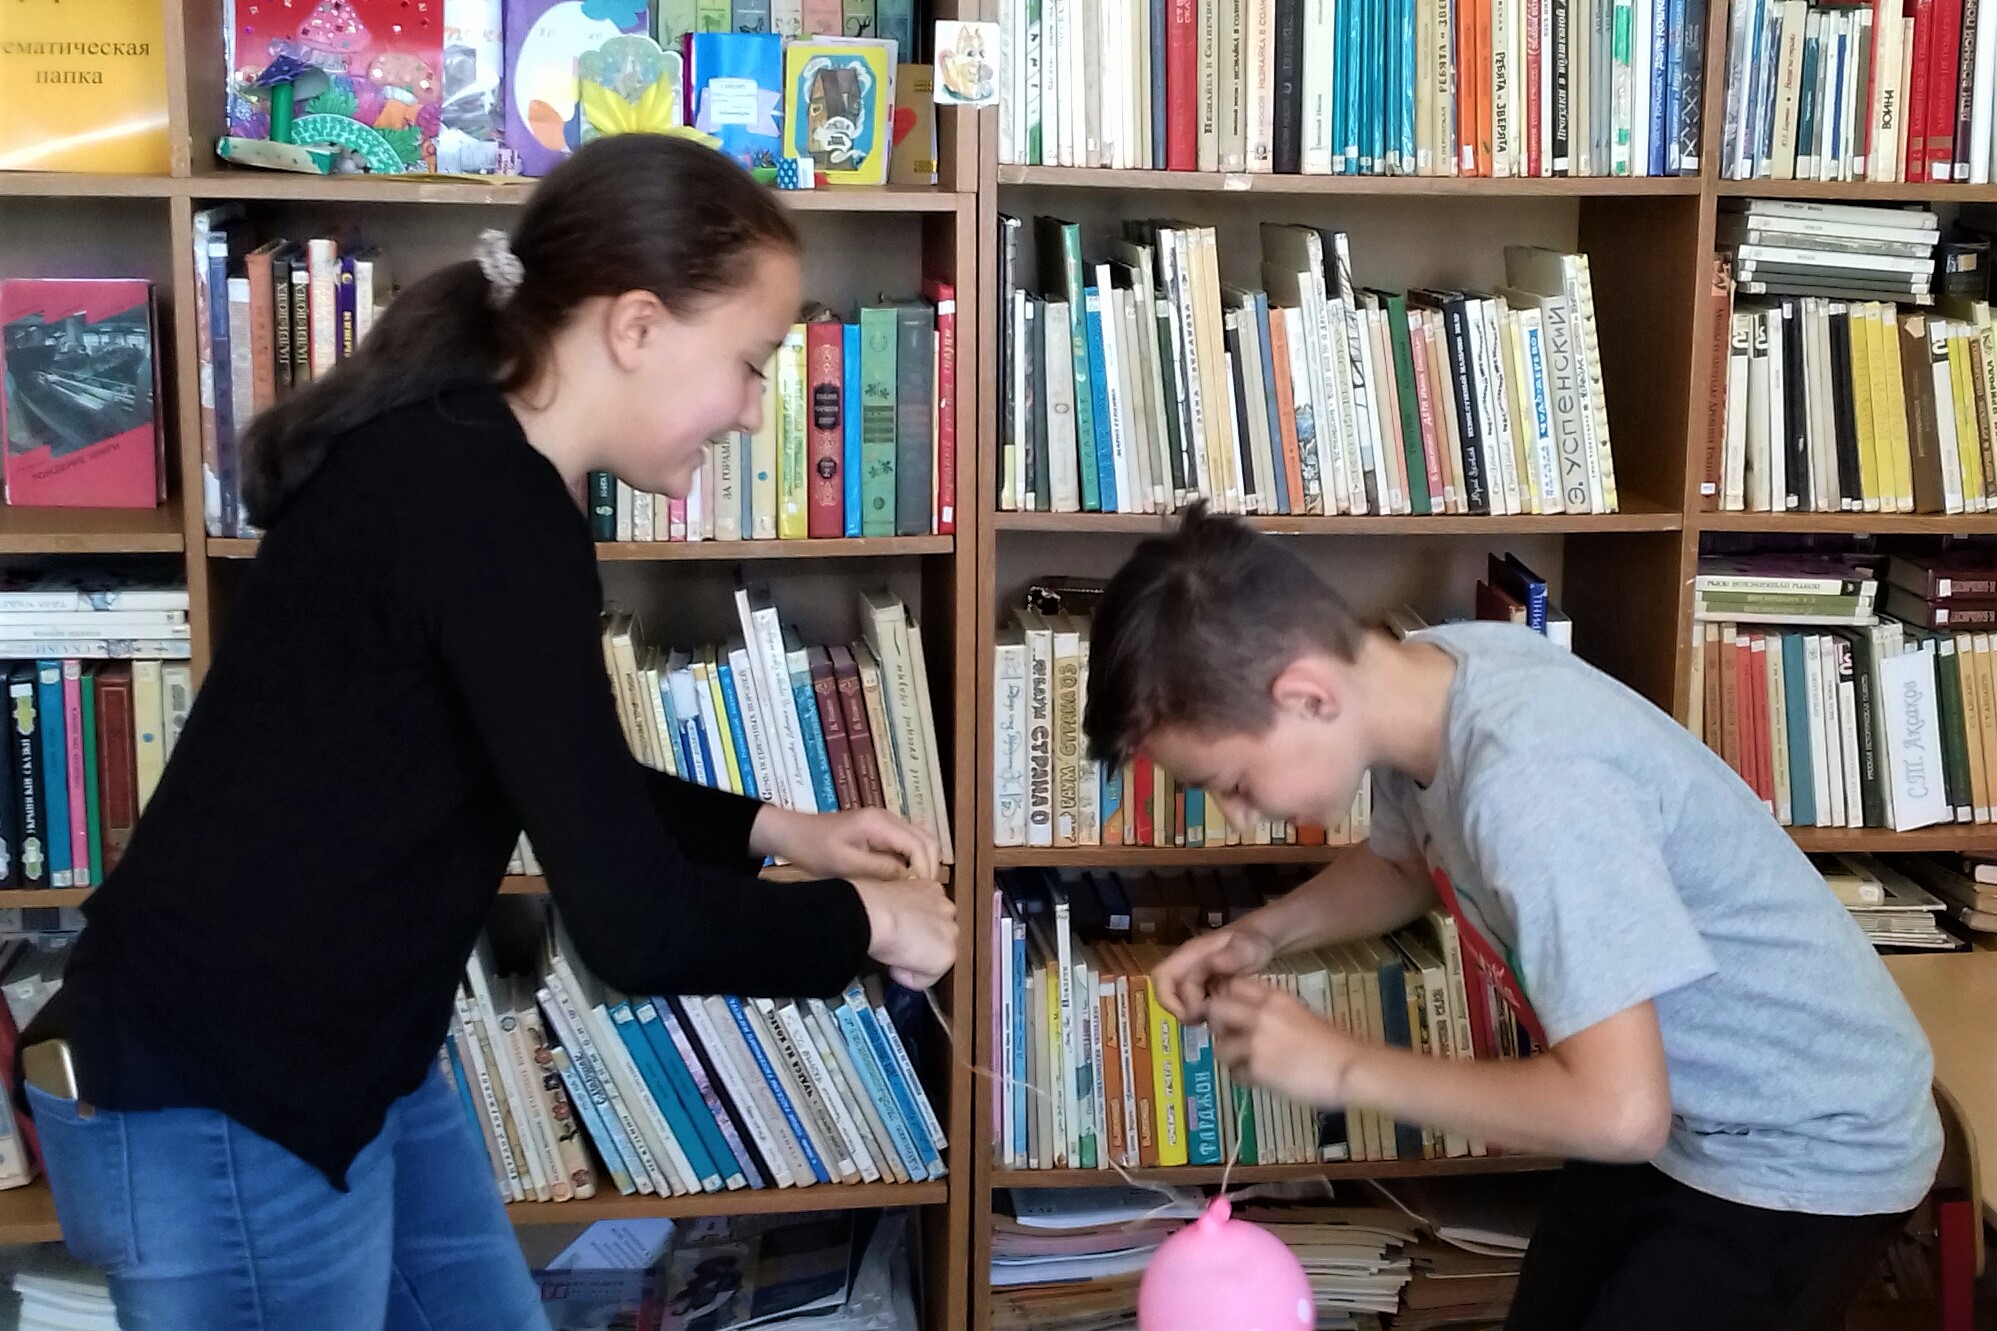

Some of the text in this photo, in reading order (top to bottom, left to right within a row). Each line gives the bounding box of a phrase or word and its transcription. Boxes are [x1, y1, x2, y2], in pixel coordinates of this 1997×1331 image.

[35, 67, 103, 85] папка
[1438, 44, 1448, 93] РЕБЯТА
[1495, 51, 1507, 92] РЕБЯТА
[1496, 103, 1508, 154] ЗВЕРЯТА
[1557, 89, 1569, 141] Прогулки
[722, 485, 731, 500] ЗА
[1567, 481, 1586, 505] Э.
[1032, 677, 1047, 720] БАУМ
[1903, 680, 1925, 750] Аксаков
[1059, 663, 1077, 809] БАУМ СТРАНА ОЗ
[1031, 725, 1049, 806] СТРАНА
[783, 1044, 795, 1059] НА
[791, 1060, 815, 1097] ЧУДЕСА
